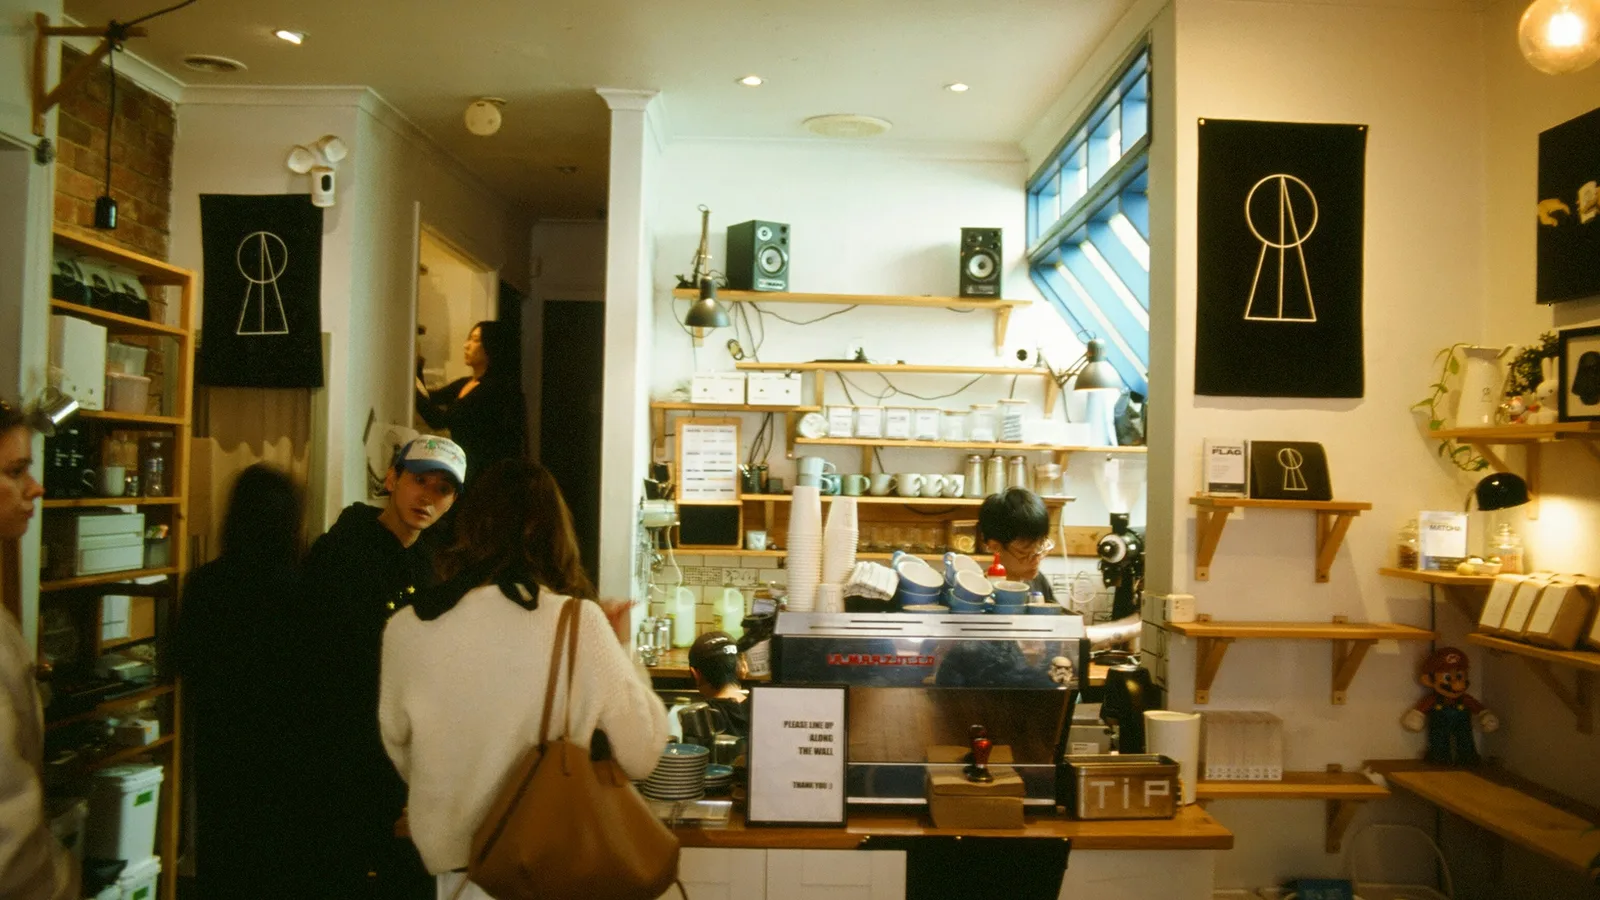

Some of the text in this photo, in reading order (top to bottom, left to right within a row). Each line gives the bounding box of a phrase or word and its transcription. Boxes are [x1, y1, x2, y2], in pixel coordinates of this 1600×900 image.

[1212, 448, 1242, 456] FLAG
[783, 720, 834, 730] PLEASE LINE UP
[809, 734, 834, 742] ALONG
[798, 747, 834, 756] THE WALL
[793, 781, 814, 789] THANK
[815, 782, 827, 790] YOU
